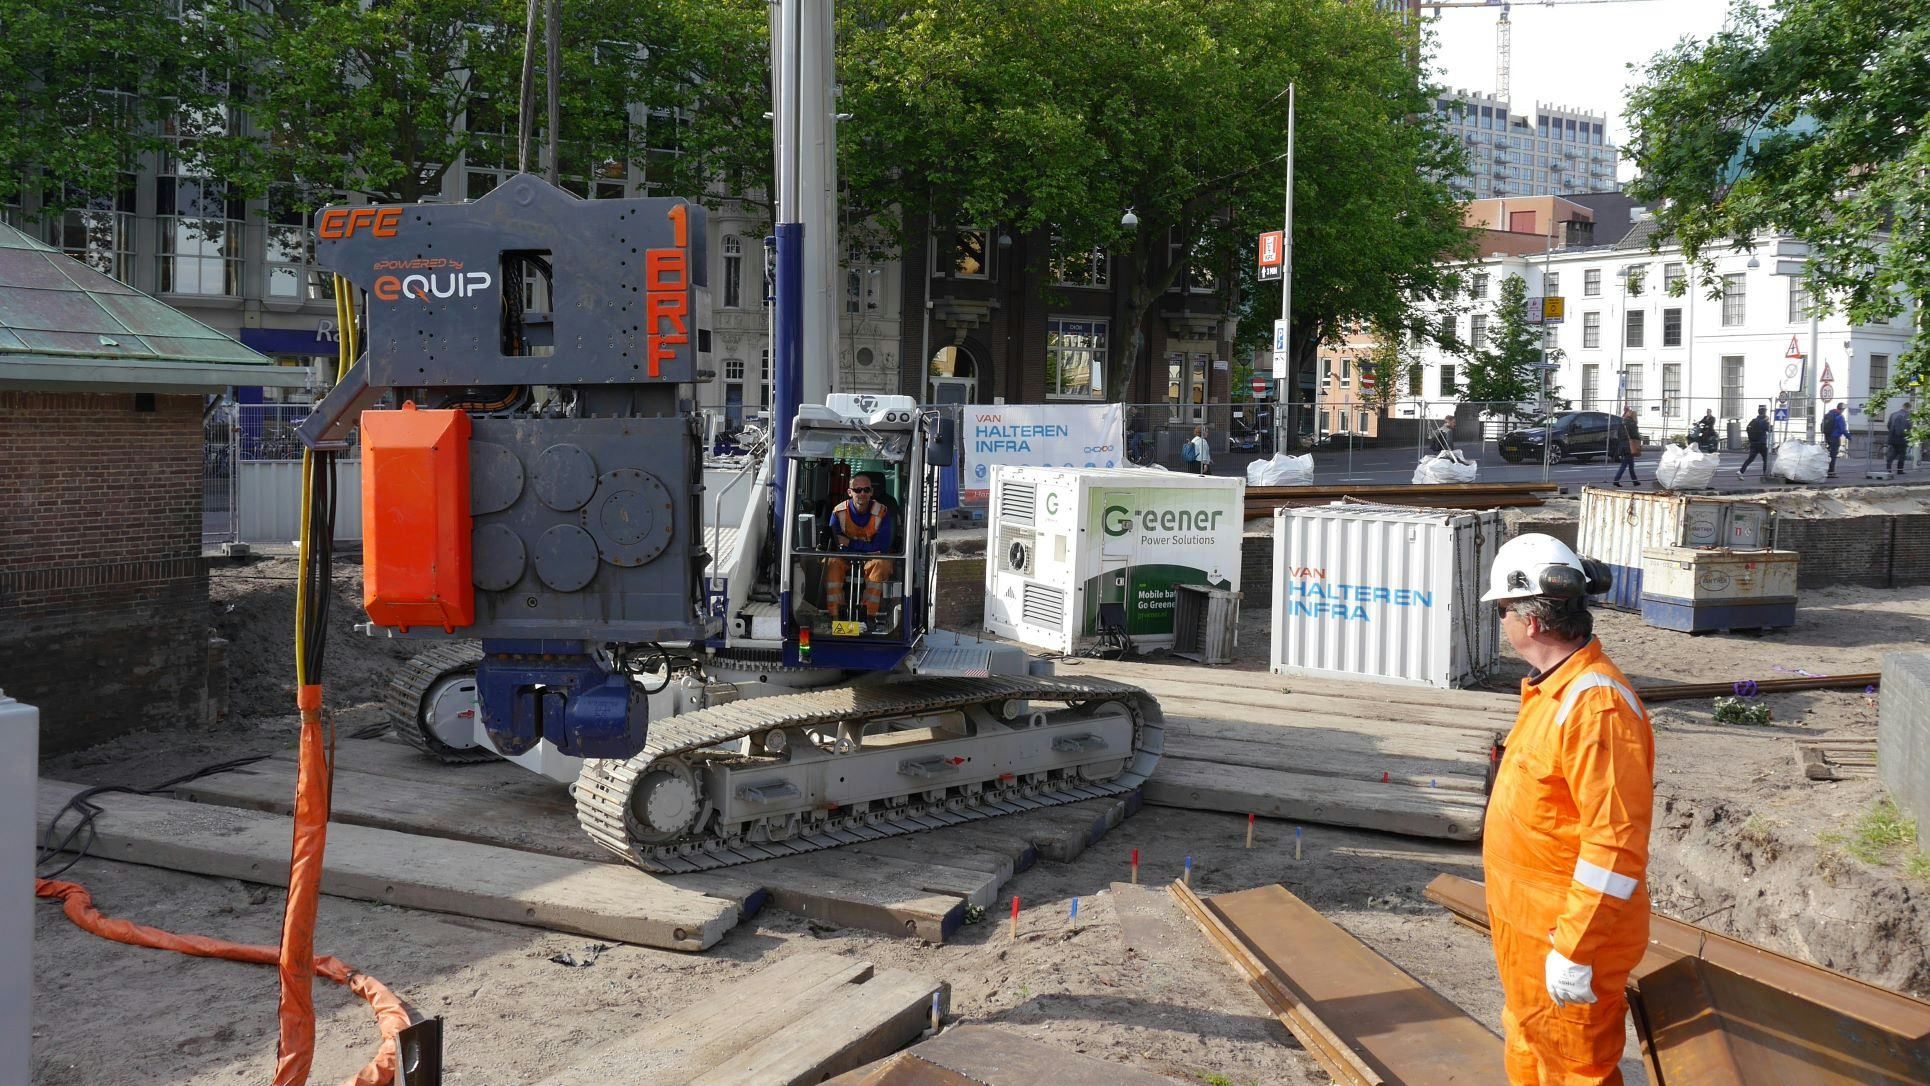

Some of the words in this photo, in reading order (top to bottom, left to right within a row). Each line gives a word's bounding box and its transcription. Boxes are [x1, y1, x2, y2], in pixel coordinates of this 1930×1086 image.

[319, 207, 404, 239] EFE
[374, 271, 492, 303] eQUIP
[975, 414, 1001, 423] VAN
[975, 424, 1068, 438] HALTEREN
[975, 440, 1031, 453] INFRA
[1141, 535, 1171, 545] Power
[1172, 534, 1215, 545] Solutions
[1289, 566, 1326, 579] VAN
[1138, 590, 1163, 599] Mobile
[1289, 580, 1433, 608] HALTEREN
[1137, 601, 1149, 609] Go
[1288, 600, 1370, 622] INFRA
